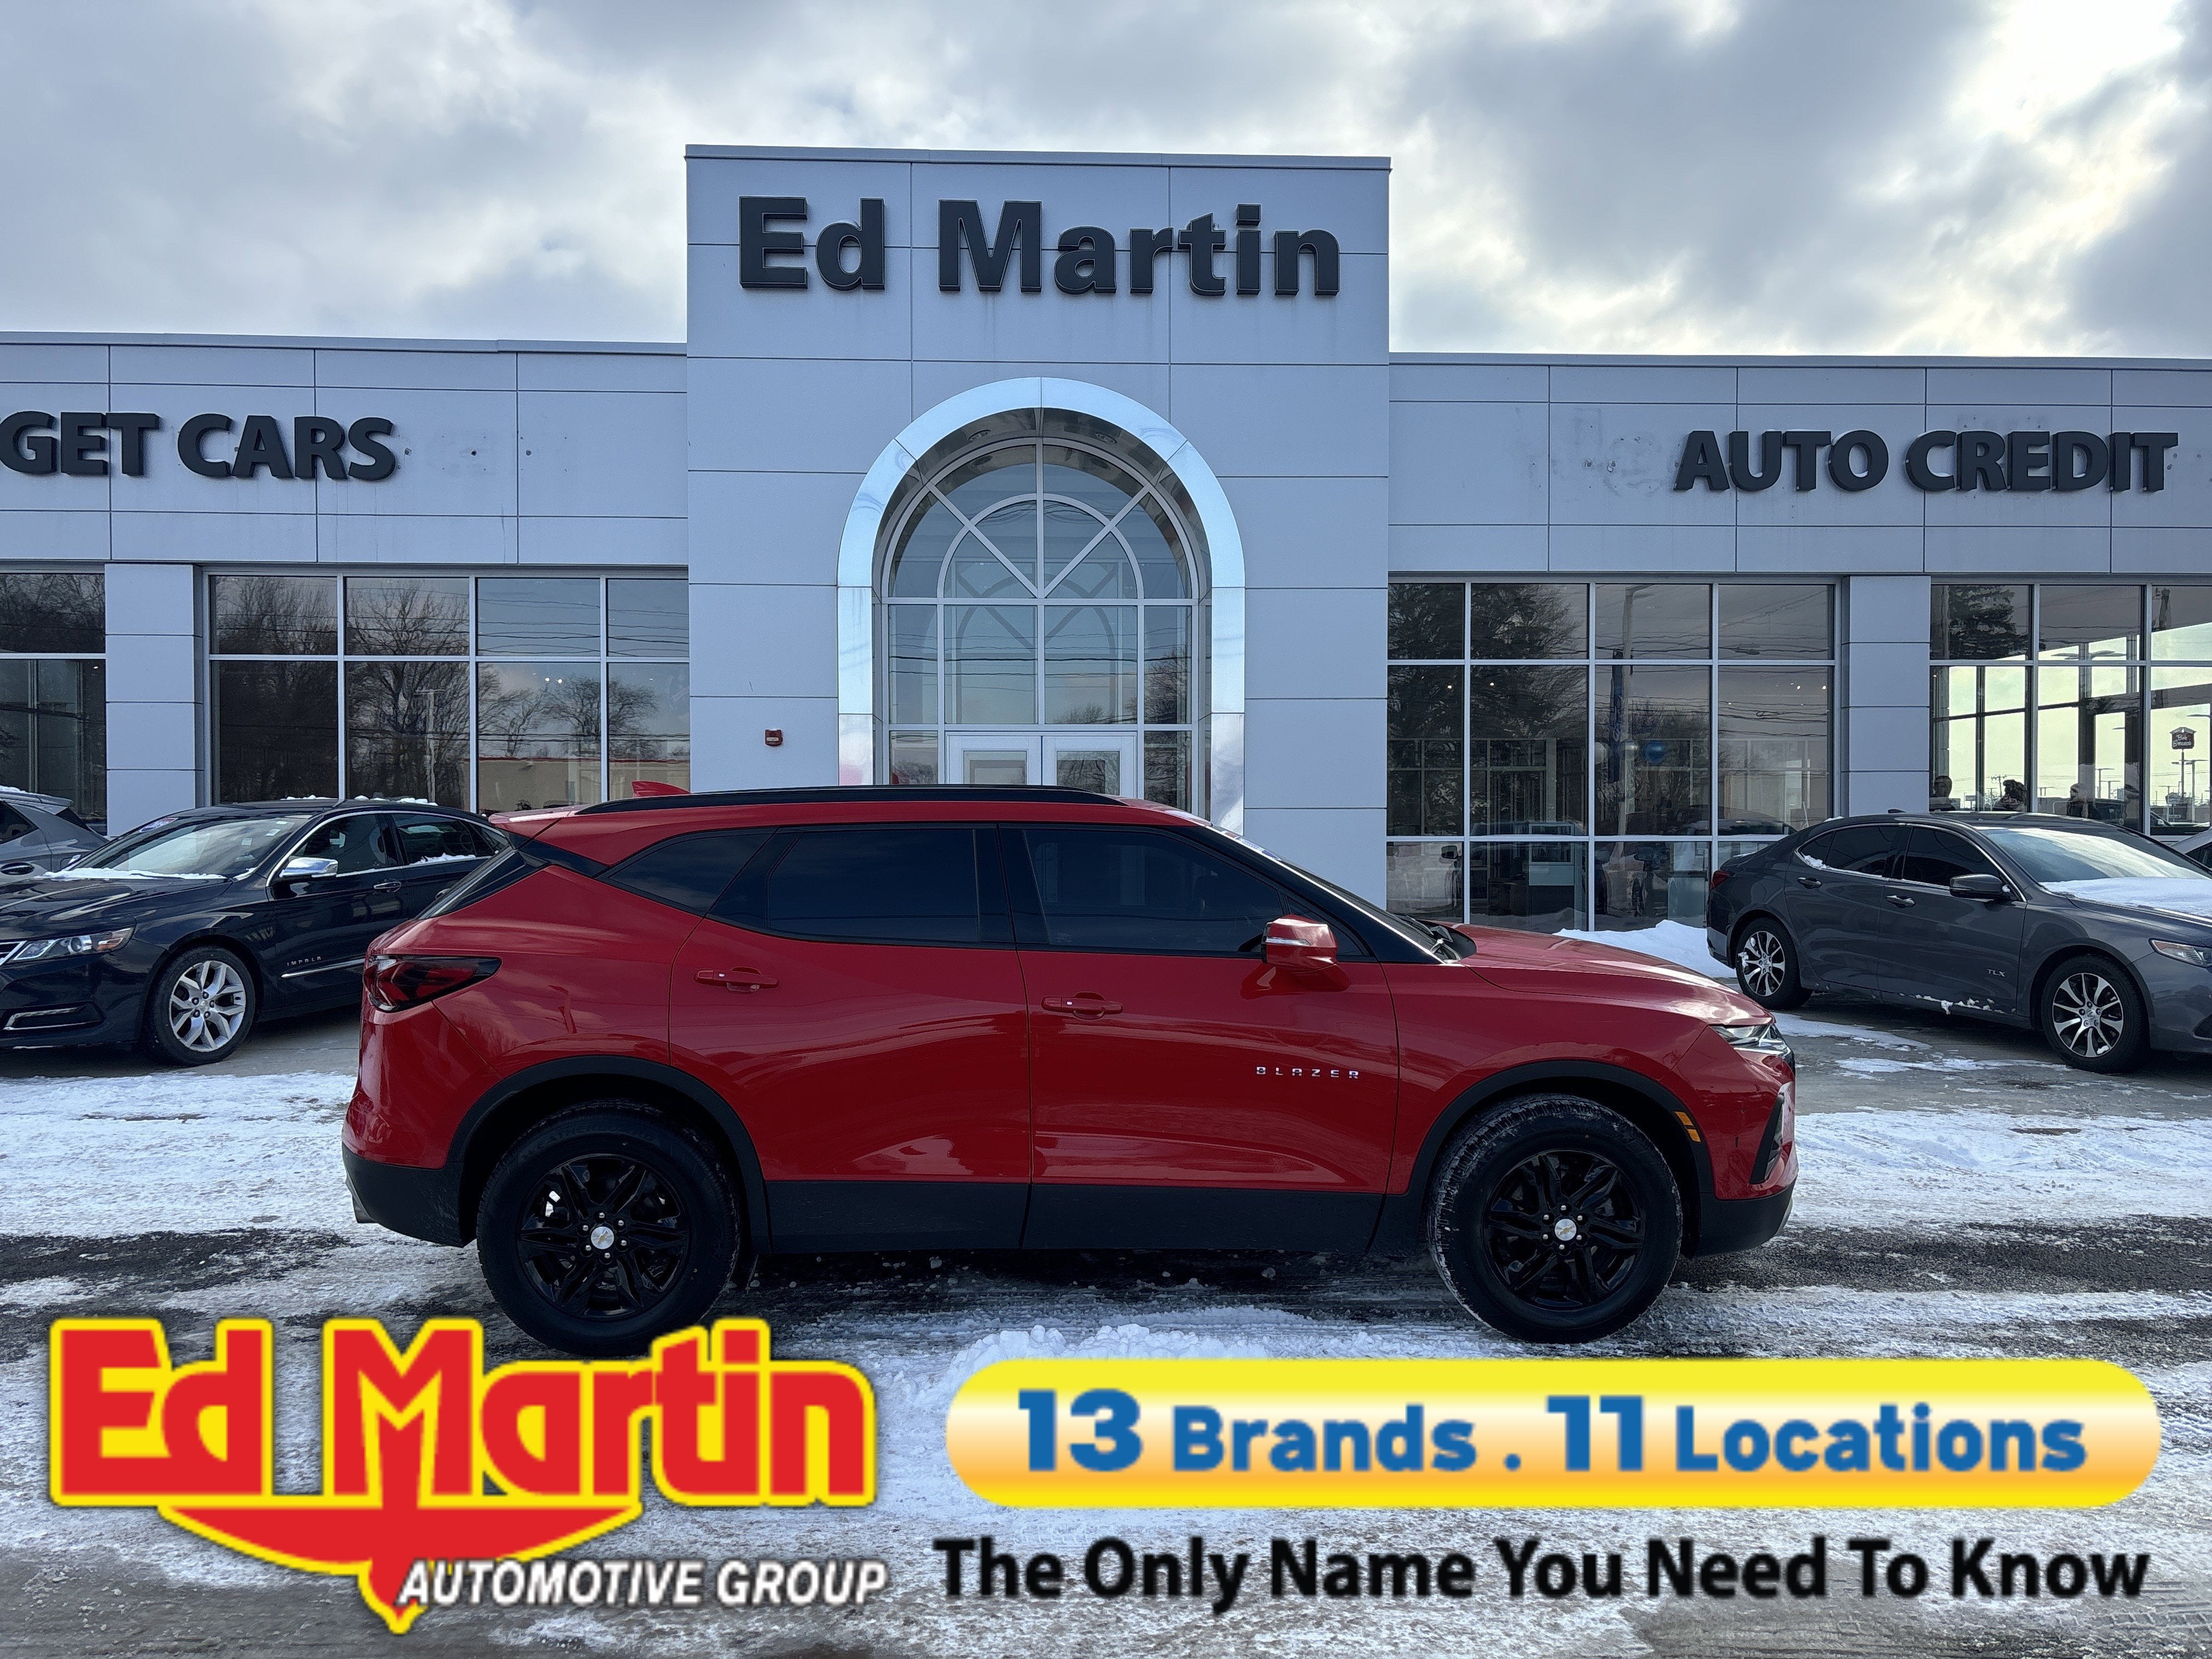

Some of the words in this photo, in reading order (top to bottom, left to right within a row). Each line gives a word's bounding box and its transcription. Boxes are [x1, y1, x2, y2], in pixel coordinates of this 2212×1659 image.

[739, 196, 884, 290] Ed
[938, 199, 1340, 295] Martin
[177, 413, 397, 481] CARS
[1673, 430, 1889, 492] AUTO
[1905, 430, 2179, 492] CREDIT
[286, 956, 321, 967] IMPALA
[1256, 1066, 1358, 1079] BLAZER
